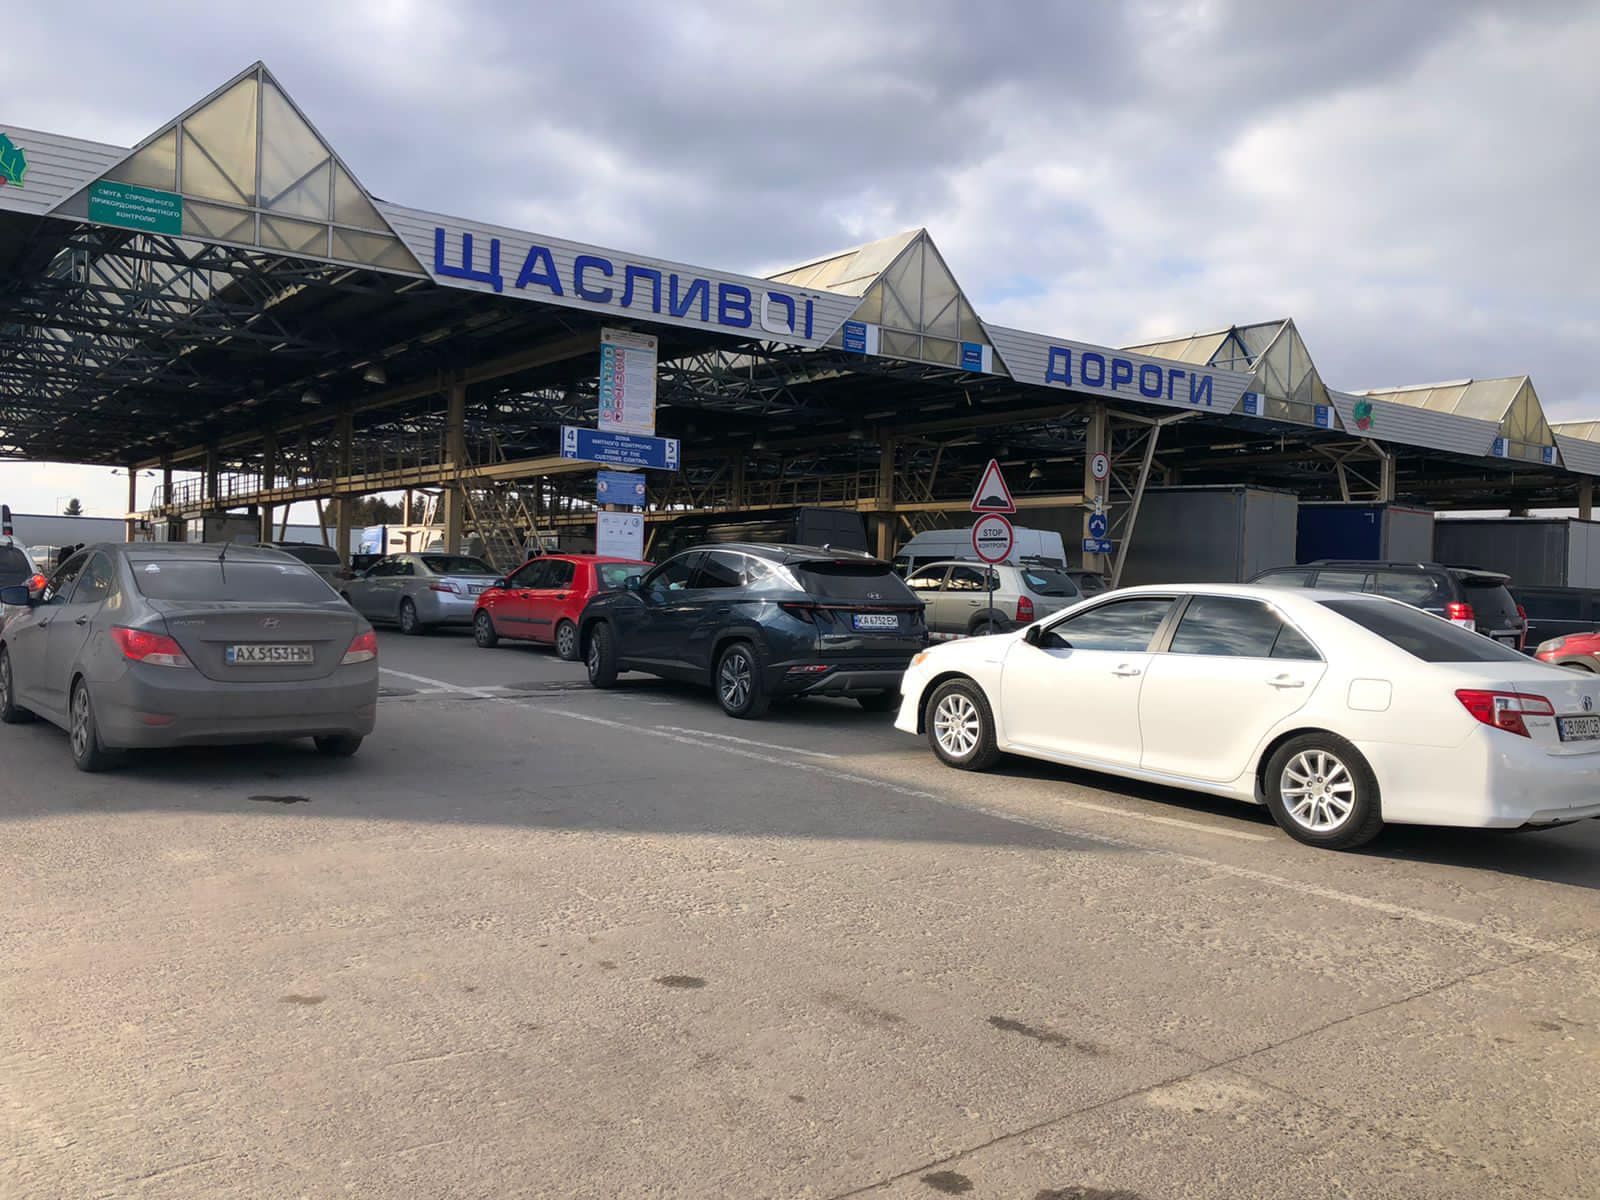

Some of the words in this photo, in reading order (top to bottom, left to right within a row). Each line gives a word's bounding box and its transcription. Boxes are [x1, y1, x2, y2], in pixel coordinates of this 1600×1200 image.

[98, 188, 122, 198] СМУГА
[116, 211, 156, 223] КОНТРОЛЮ
[1045, 346, 1213, 407] ДОРОГИ
[567, 430, 575, 440] 4
[668, 442, 674, 453] 5
[1097, 459, 1103, 472] 5
[983, 529, 1003, 537] STOP
